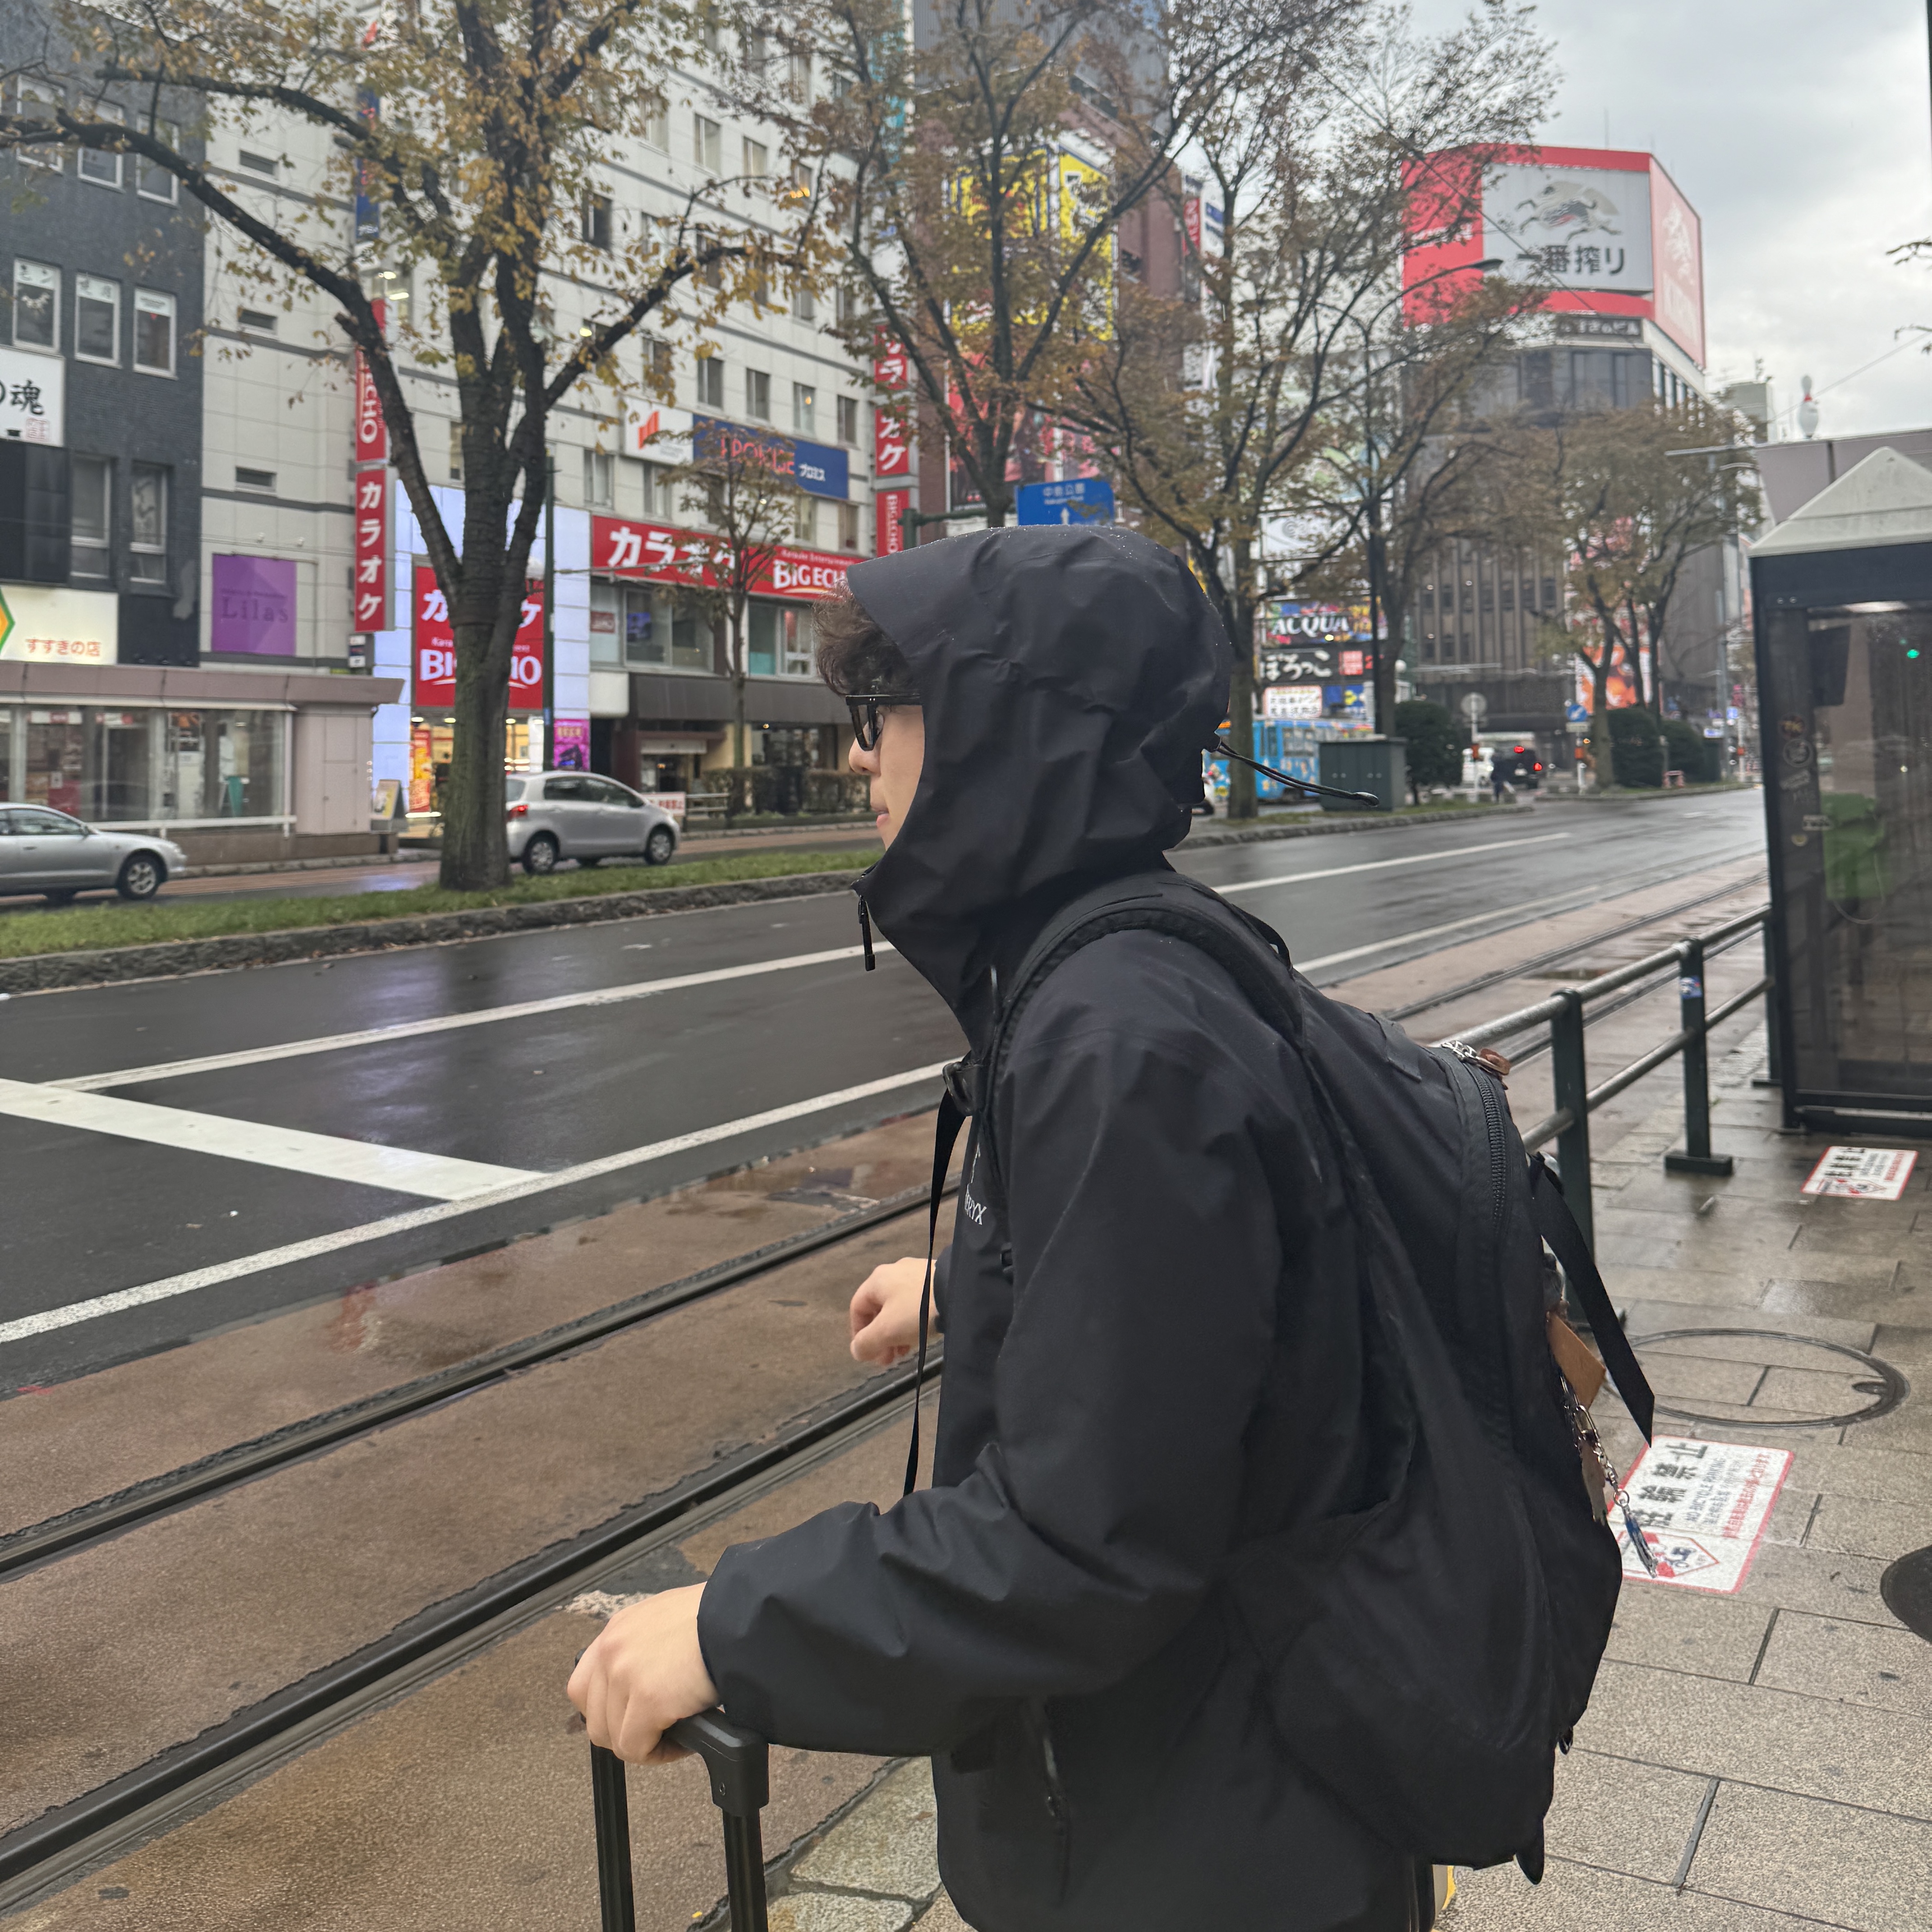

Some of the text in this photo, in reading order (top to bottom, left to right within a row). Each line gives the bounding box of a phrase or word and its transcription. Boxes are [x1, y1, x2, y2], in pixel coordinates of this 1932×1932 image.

[358, 481, 383, 621] カラオケ
[222, 595, 289, 624] Lilas
[1271, 615, 1348, 637] ACQUA
[25, 638, 101, 657] すすきの店
